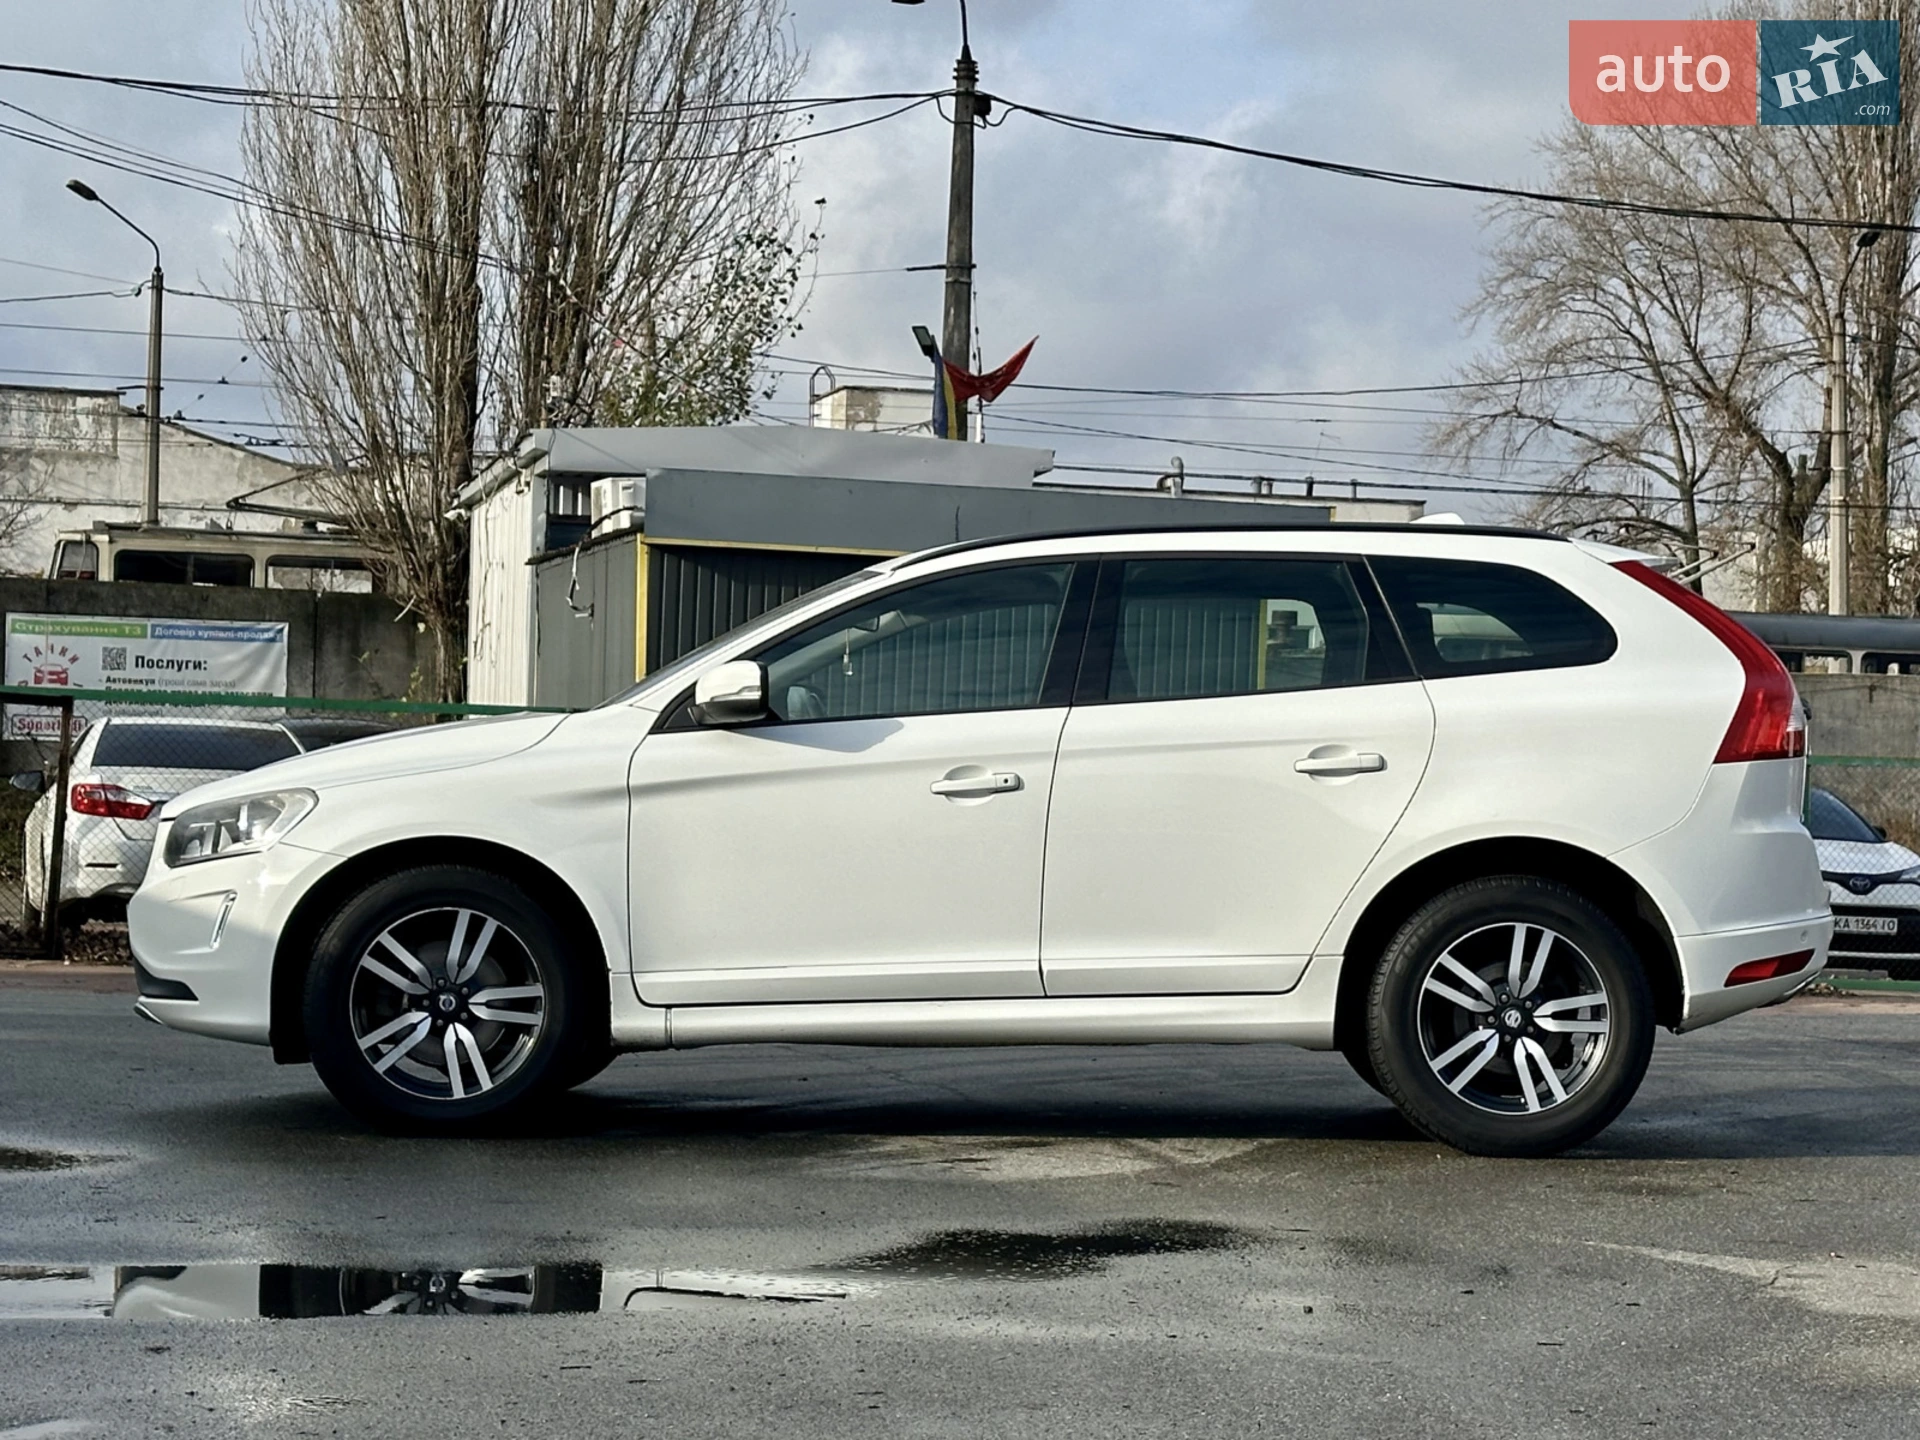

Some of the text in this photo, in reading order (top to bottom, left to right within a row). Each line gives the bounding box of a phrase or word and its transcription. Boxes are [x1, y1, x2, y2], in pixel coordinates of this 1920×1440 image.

[15, 622, 142, 636] Страхування ТЗ
[154, 626, 196, 638] Договір
[135, 655, 208, 672] Послуги:
